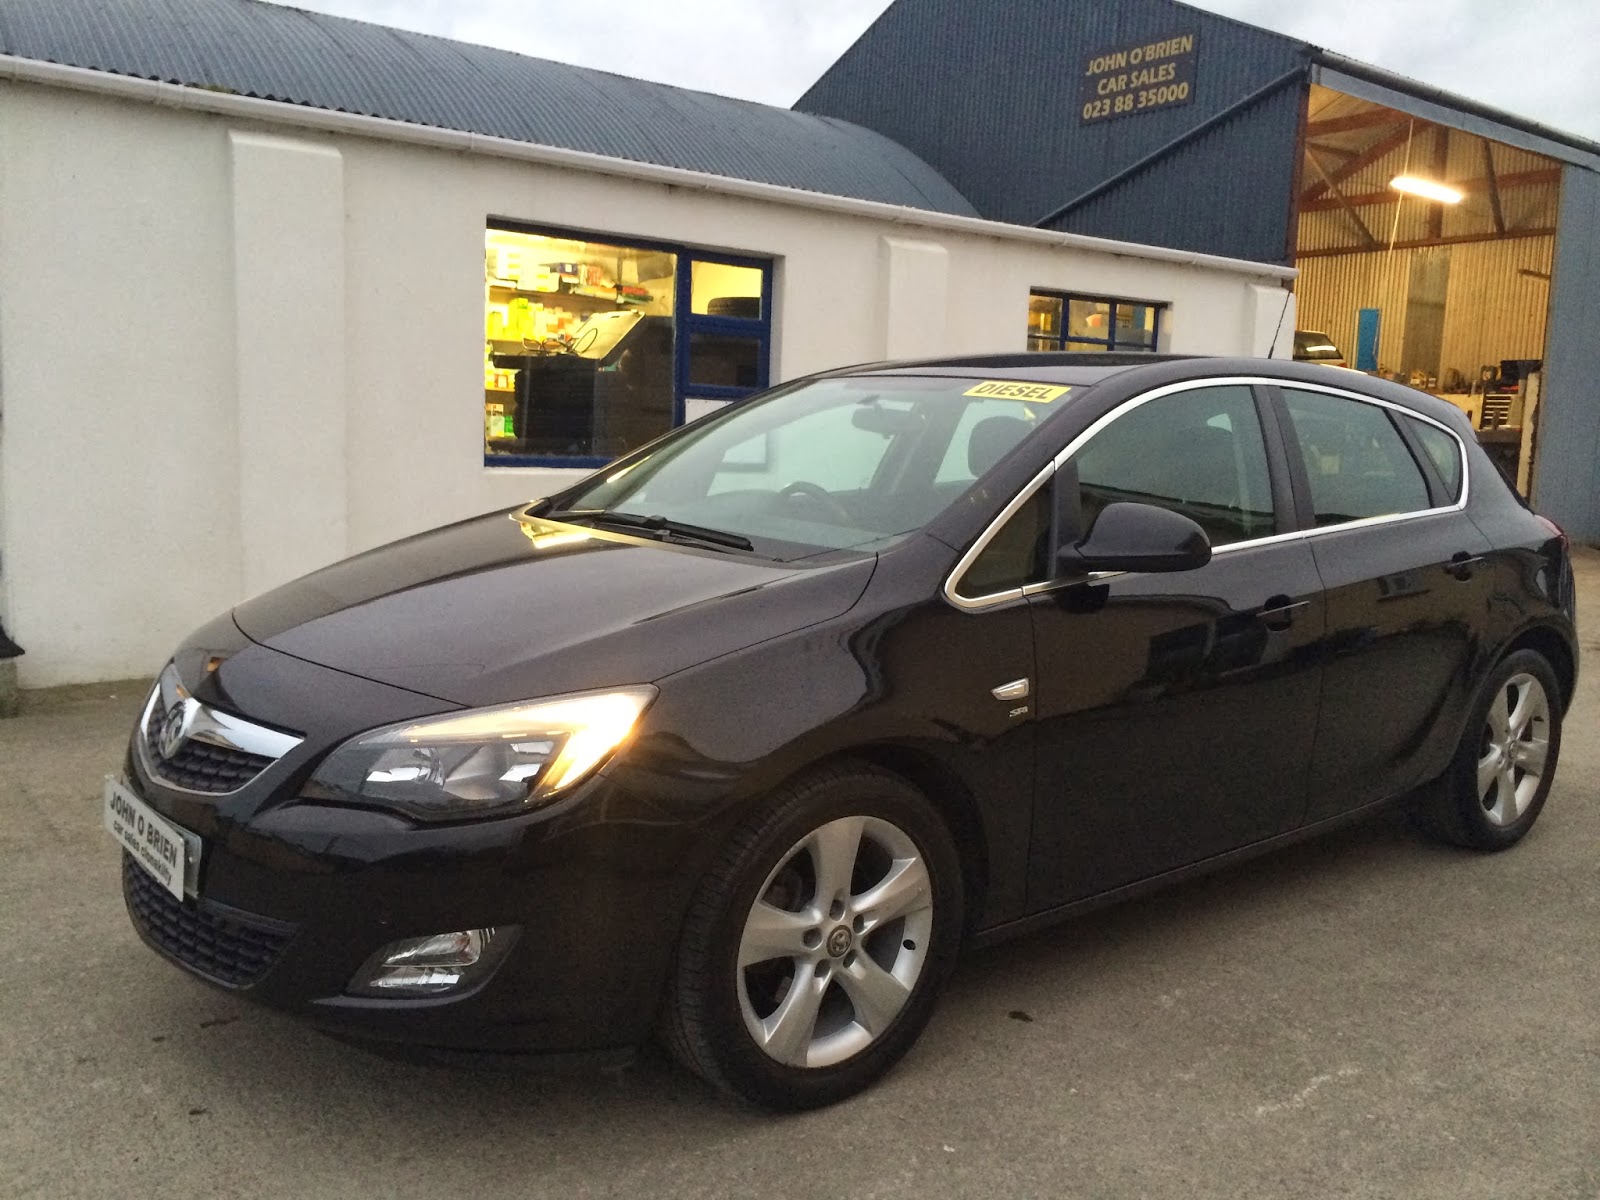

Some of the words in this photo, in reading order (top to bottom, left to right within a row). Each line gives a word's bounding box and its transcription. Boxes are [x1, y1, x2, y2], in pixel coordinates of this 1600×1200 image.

[1085, 51, 1127, 75] JOHN
[1130, 35, 1193, 64] O'BRIEN
[1097, 74, 1127, 95] CAR
[1130, 62, 1176, 87] SALES
[1083, 99, 1111, 119] 023
[1114, 94, 1134, 113] 88
[1137, 82, 1189, 108] 35000
[973, 383, 1054, 400] DIESEL
[110, 791, 136, 829] JOHN
[138, 814, 144, 836] O
[147, 822, 177, 868] BRIEN
